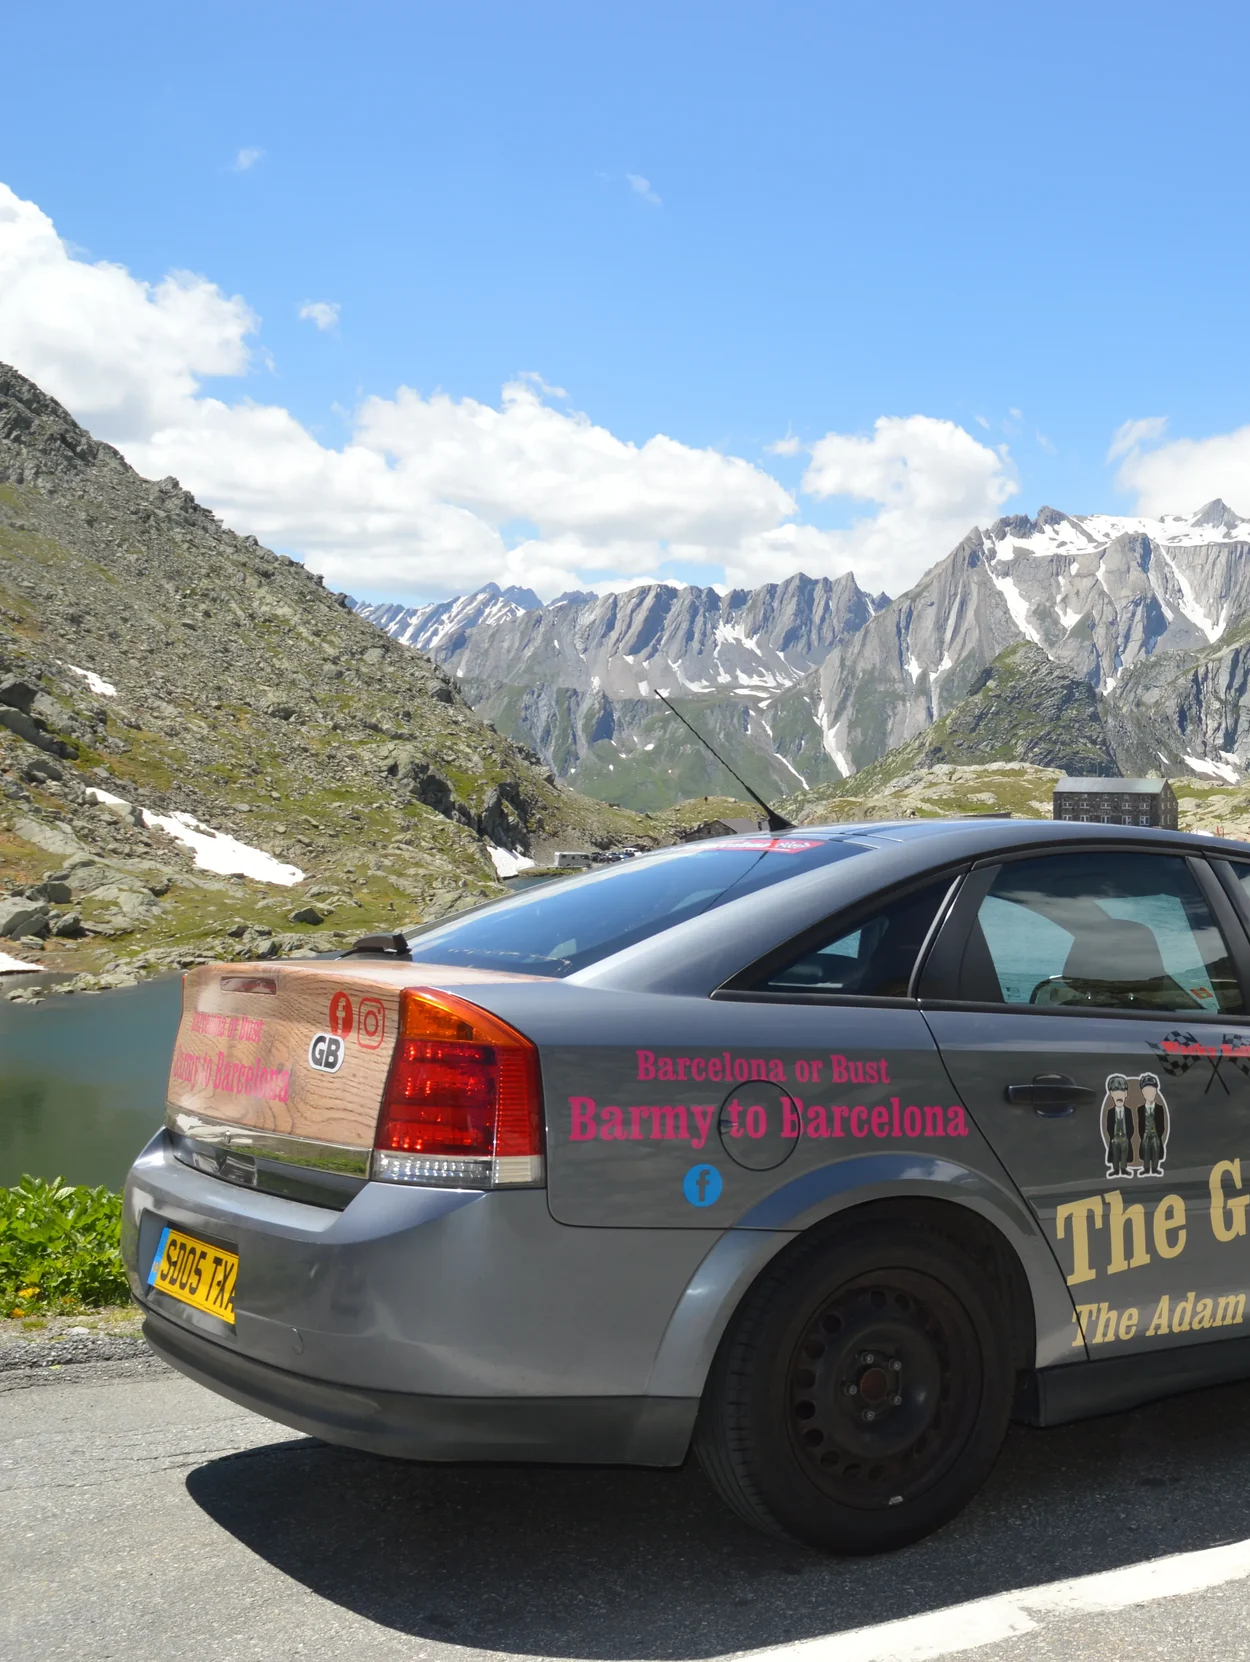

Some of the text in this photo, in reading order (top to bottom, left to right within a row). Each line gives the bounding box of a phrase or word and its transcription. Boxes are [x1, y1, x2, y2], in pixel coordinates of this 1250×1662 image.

[213, 1051, 290, 1103] Barcelona
[311, 1035, 341, 1069] GB
[636, 1050, 890, 1084] Barcelona or Bust
[568, 1096, 969, 1149] Barmy to Barcelona
[1056, 1190, 1187, 1287] The
[160, 1239, 208, 1296] SD05
[1072, 1302, 1139, 1347] The
[1145, 1291, 1246, 1336] Adam
